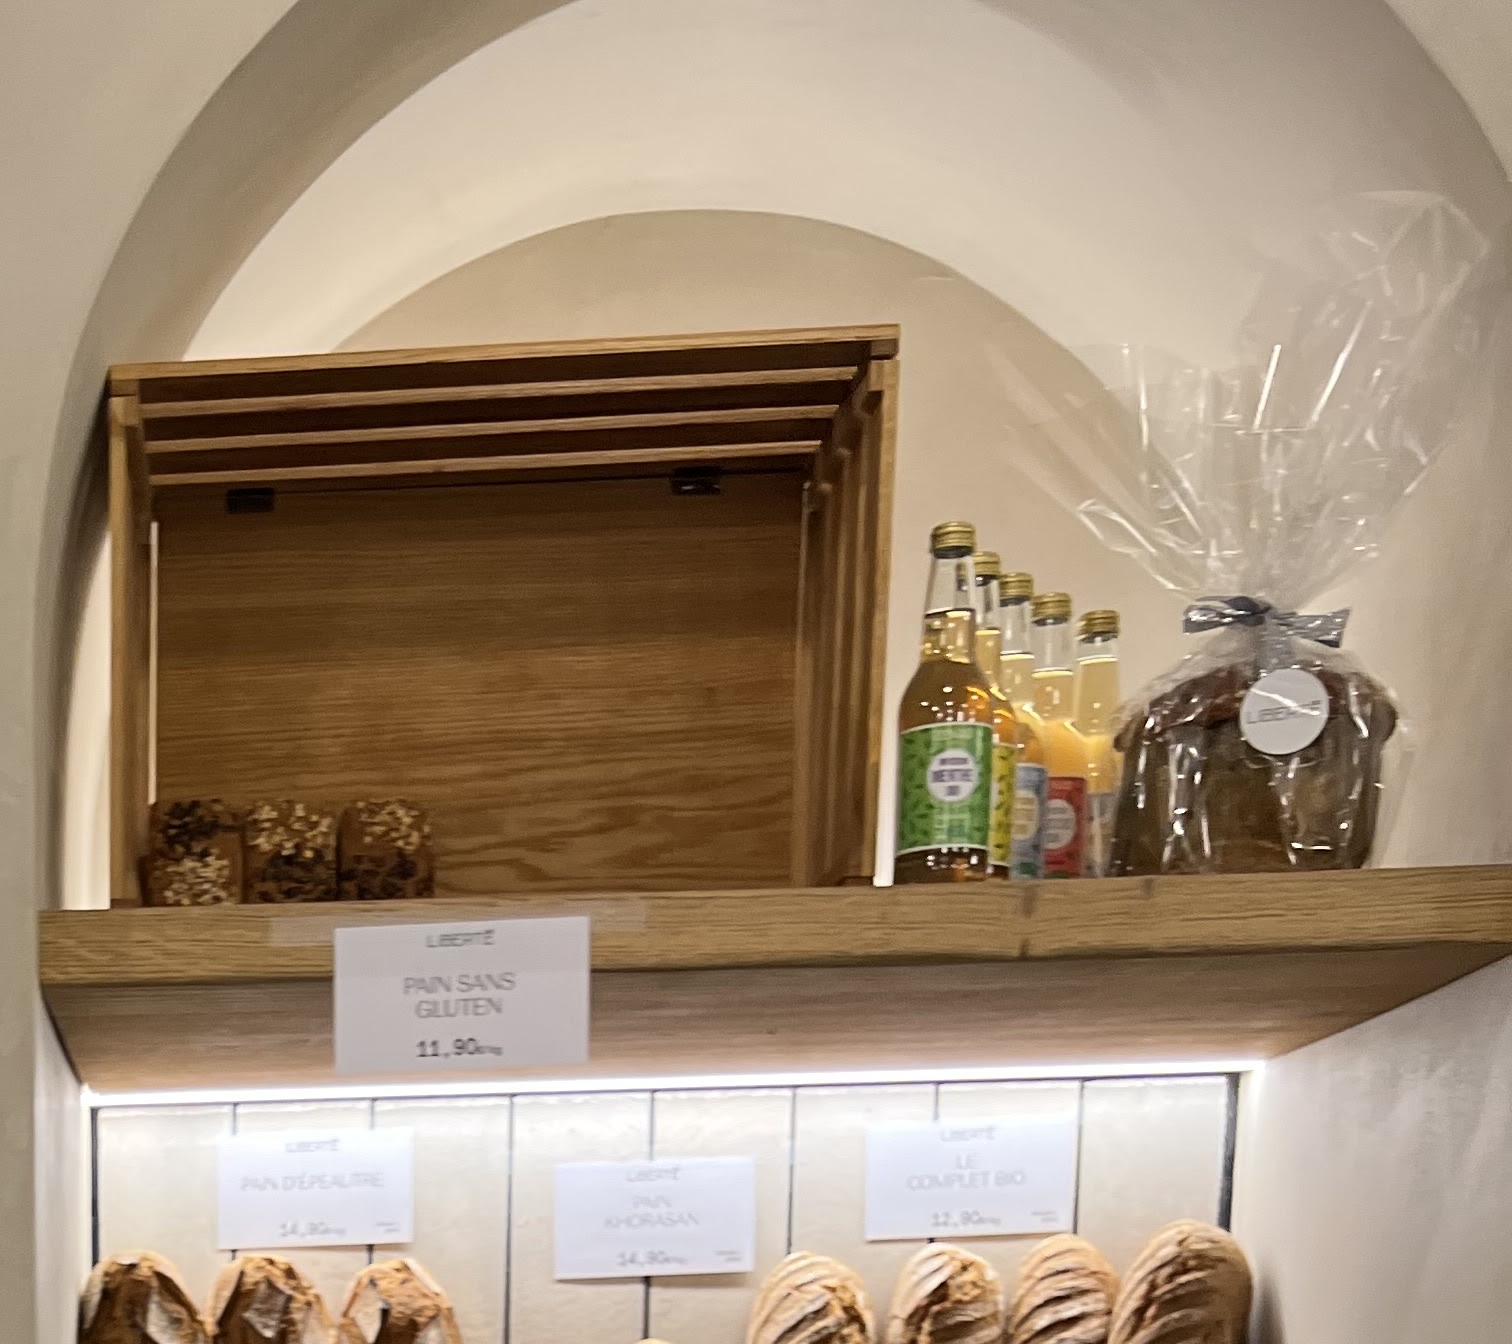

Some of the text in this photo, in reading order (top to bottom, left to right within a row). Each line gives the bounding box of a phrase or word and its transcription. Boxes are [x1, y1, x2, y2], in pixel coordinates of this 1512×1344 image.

[403, 972, 517, 994] PAIN SANS
[414, 997, 503, 1019] GLUTEN
